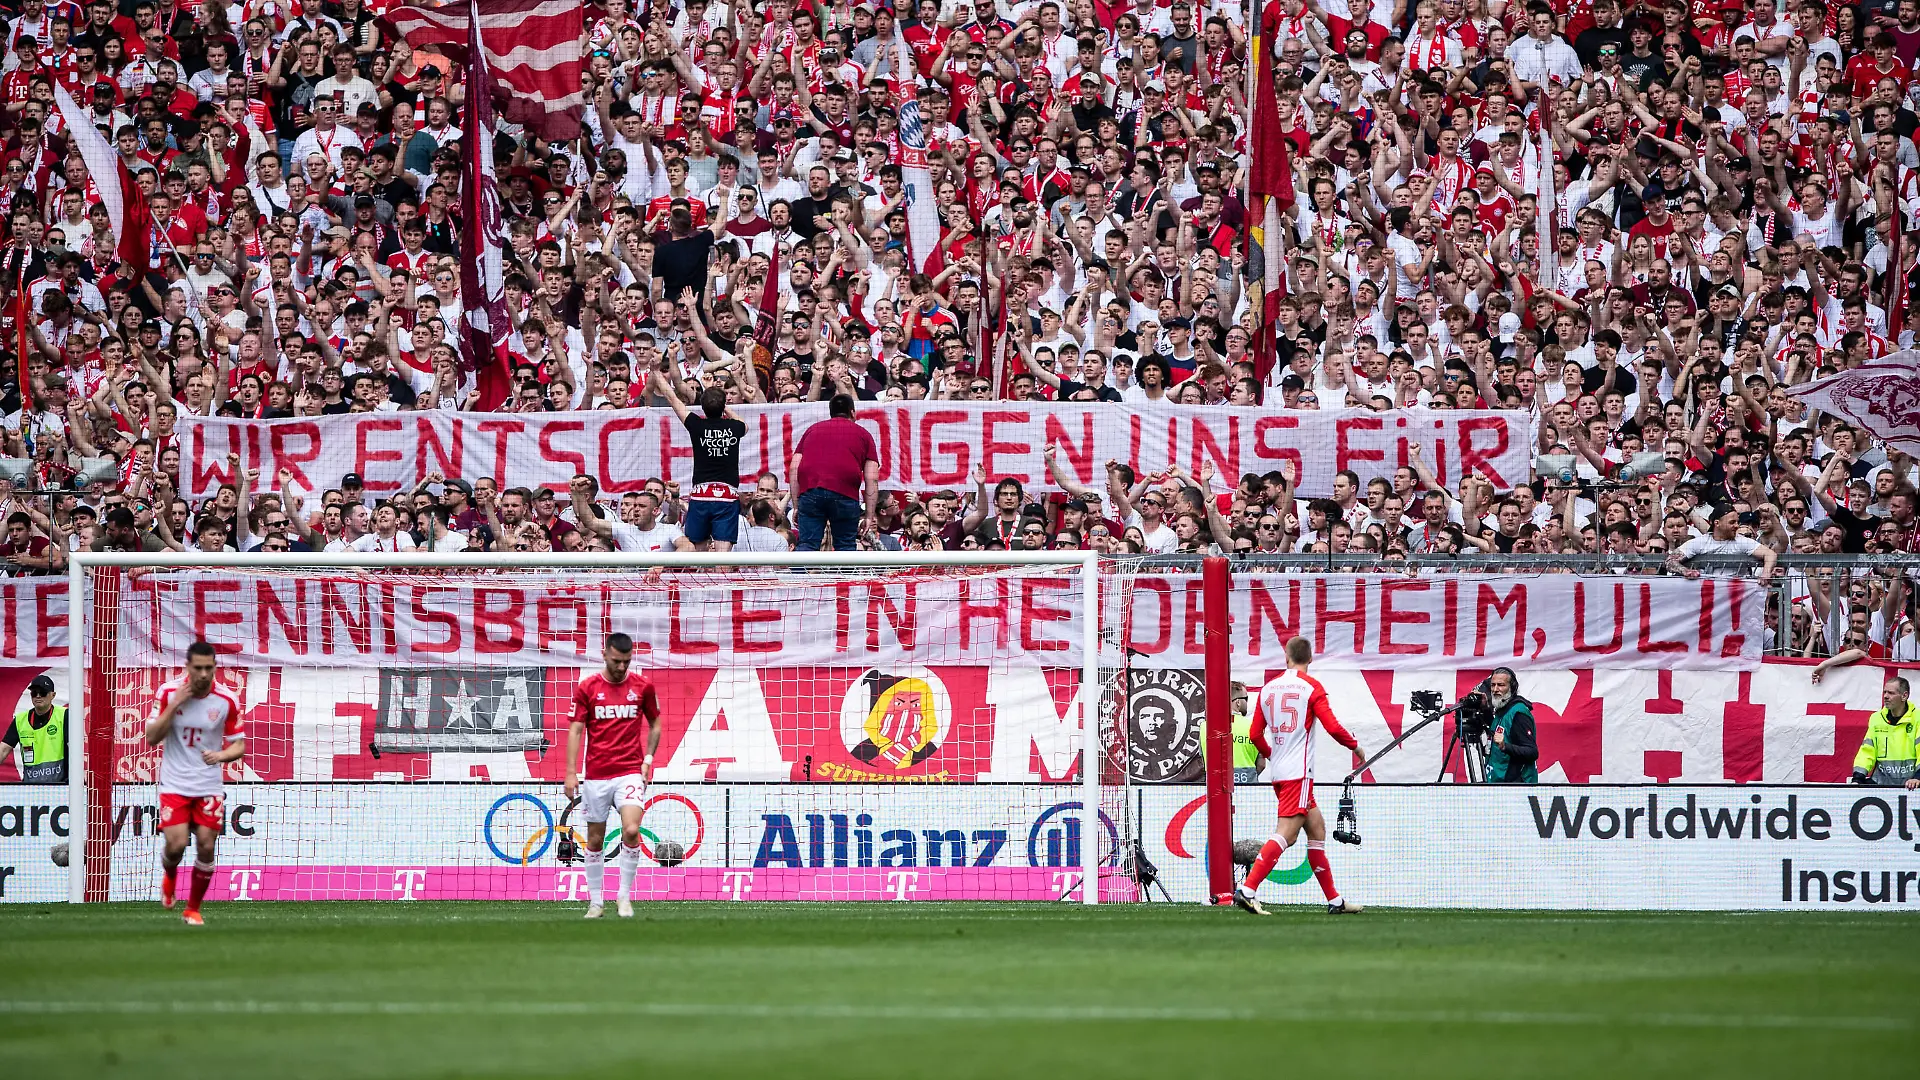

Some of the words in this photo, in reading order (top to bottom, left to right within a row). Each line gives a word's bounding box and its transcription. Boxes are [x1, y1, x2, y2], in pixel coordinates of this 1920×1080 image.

[192, 421, 322, 494] WIR
[1129, 413, 1302, 488] UNS
[1335, 416, 1510, 491] FÜR
[704, 428, 733, 439] ULTRAS
[707, 446, 729, 457] STILE
[835, 578, 917, 653] IN
[1573, 578, 1747, 659] ULI!
[594, 704, 638, 719] REWE
[1265, 693, 1299, 733] 15
[183, 727, 202, 747] T
[1528, 793, 1832, 841] Worldwide
[753, 812, 1007, 867] Allianz
[1782, 858, 1920, 904] Insur
